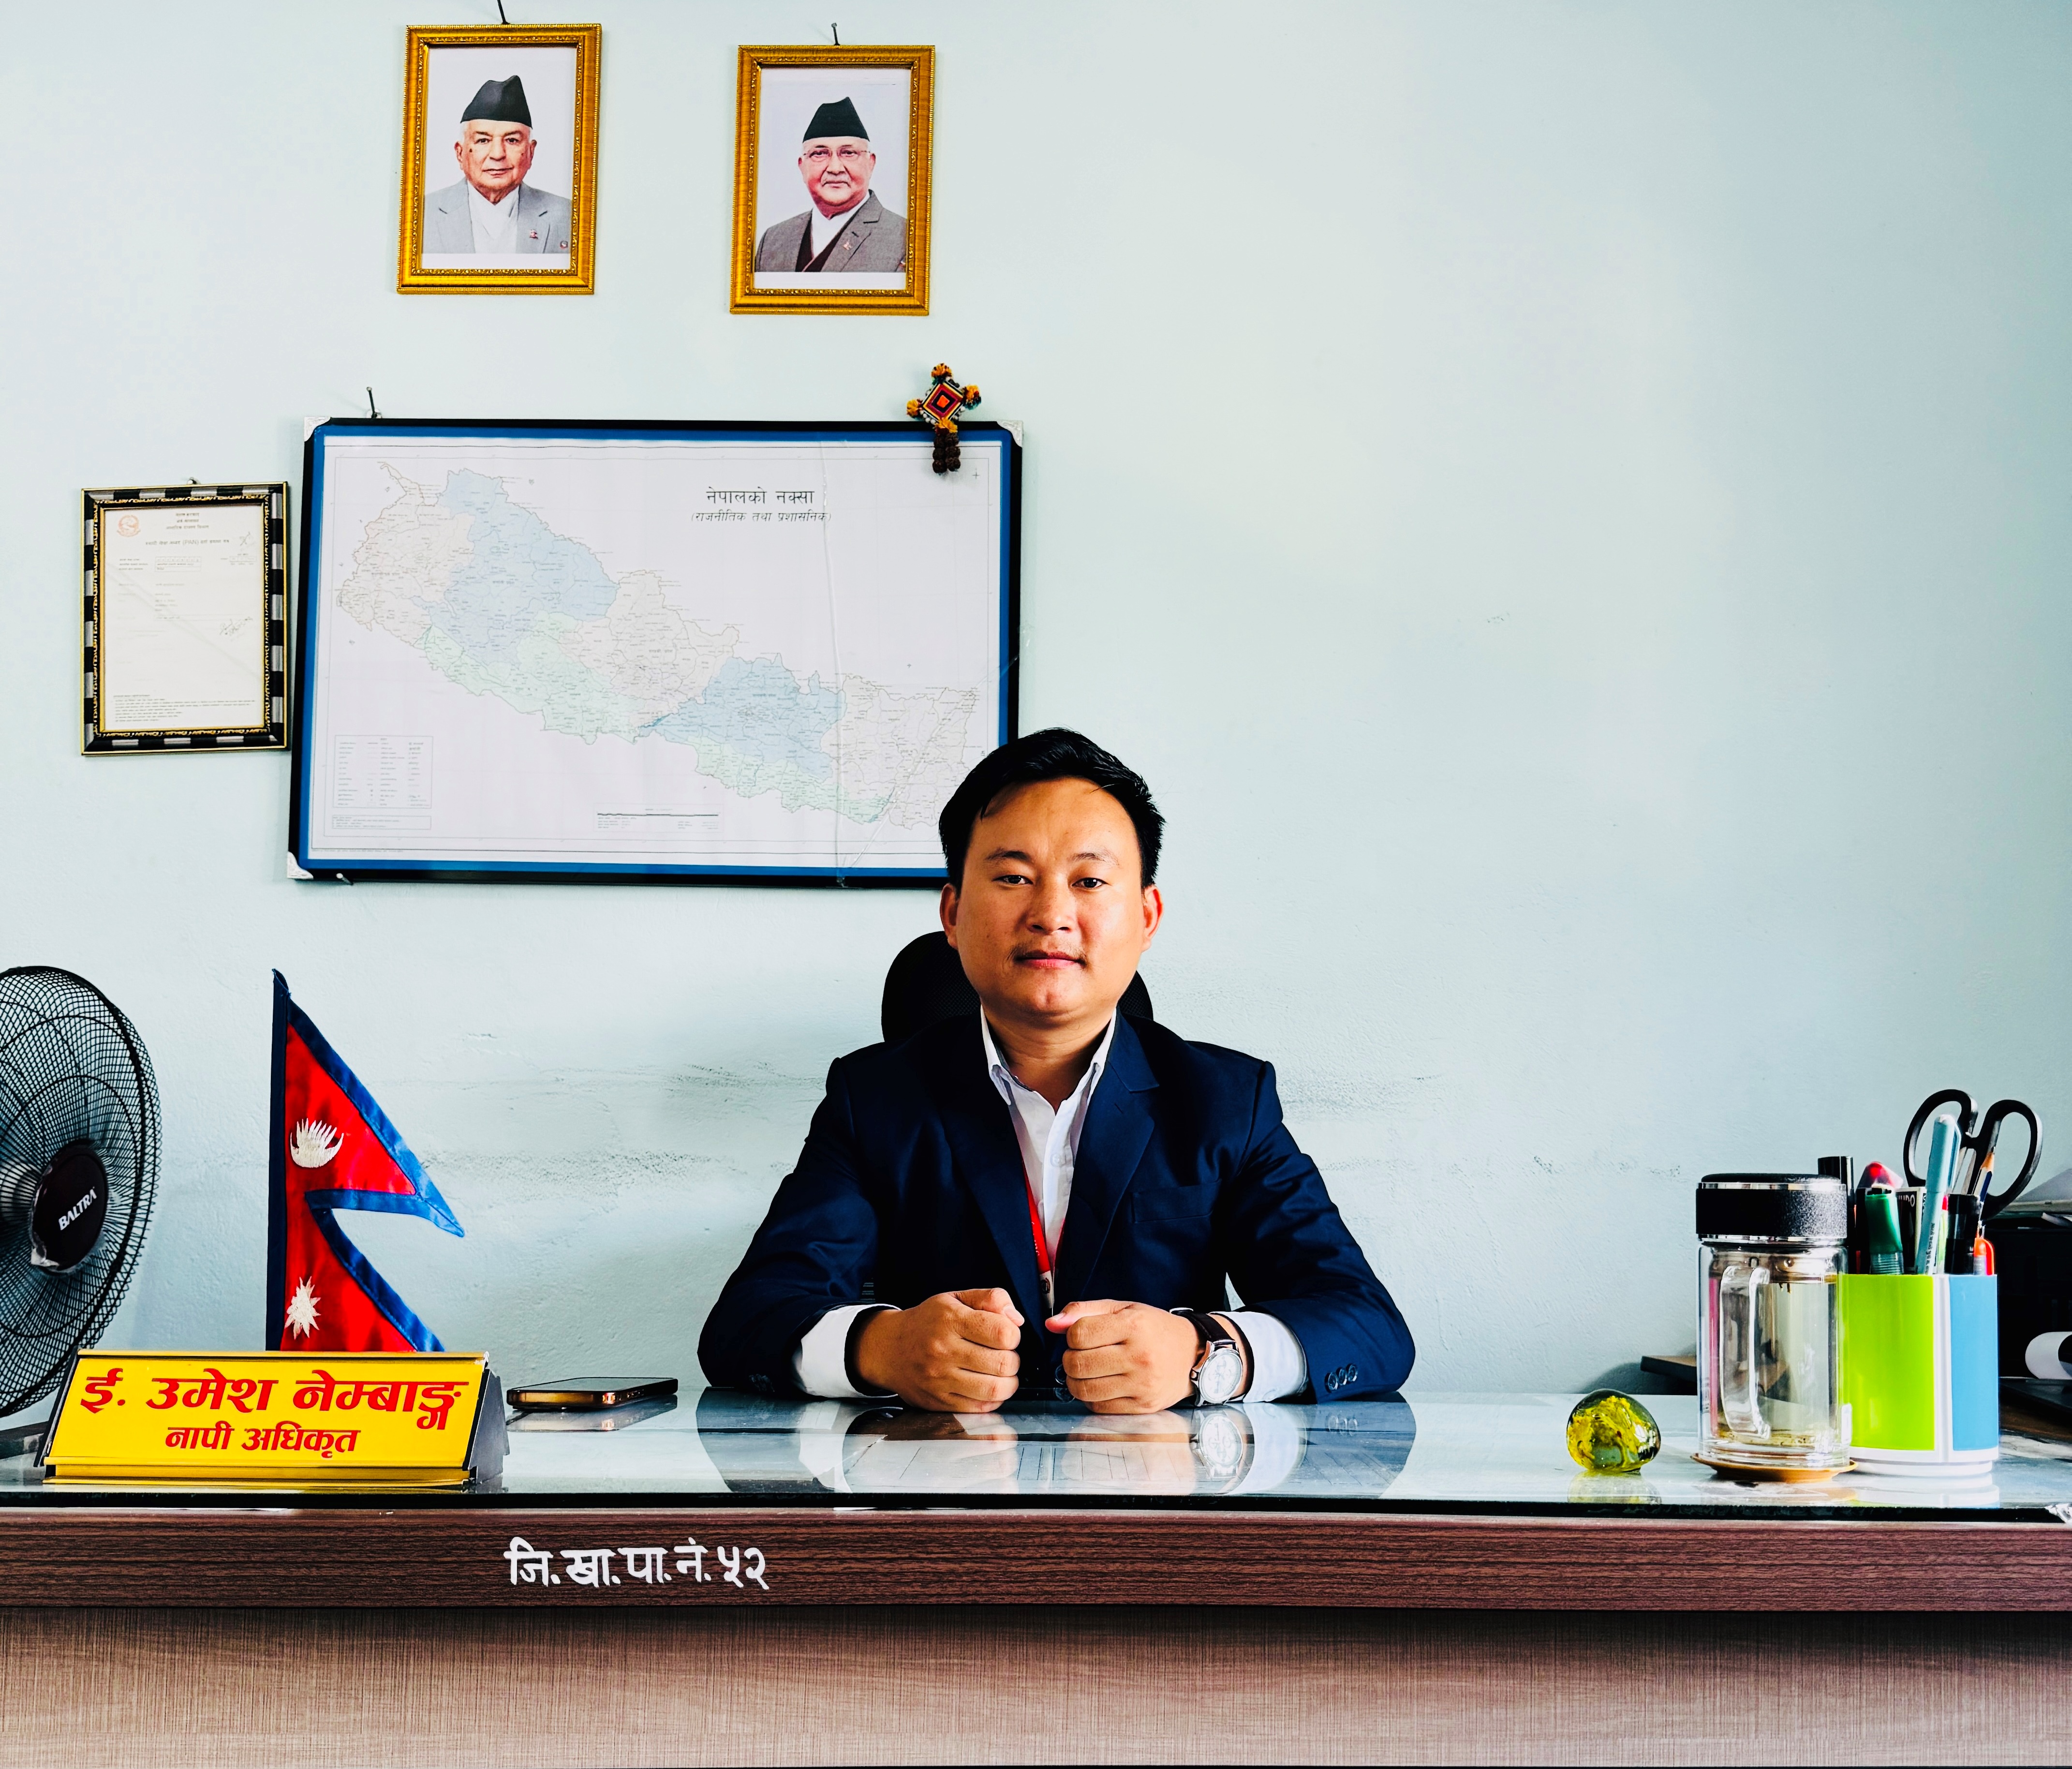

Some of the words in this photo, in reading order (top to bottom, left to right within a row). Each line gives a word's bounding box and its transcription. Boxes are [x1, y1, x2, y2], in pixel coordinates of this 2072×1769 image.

[706, 486, 767, 504] नेपालको
[775, 491, 815, 504] नक्सा
[691, 509, 747, 521] (राजनीतिक
[752, 513, 773, 521] तथा
[778, 509, 831, 521] प्रशासनिक)
[59, 1189, 97, 1231] BALTRA
[80, 1368, 126, 1414] ई.
[145, 1368, 279, 1413] उमेश
[165, 1420, 235, 1450] नापी
[241, 1420, 361, 1458] अधिकृत
